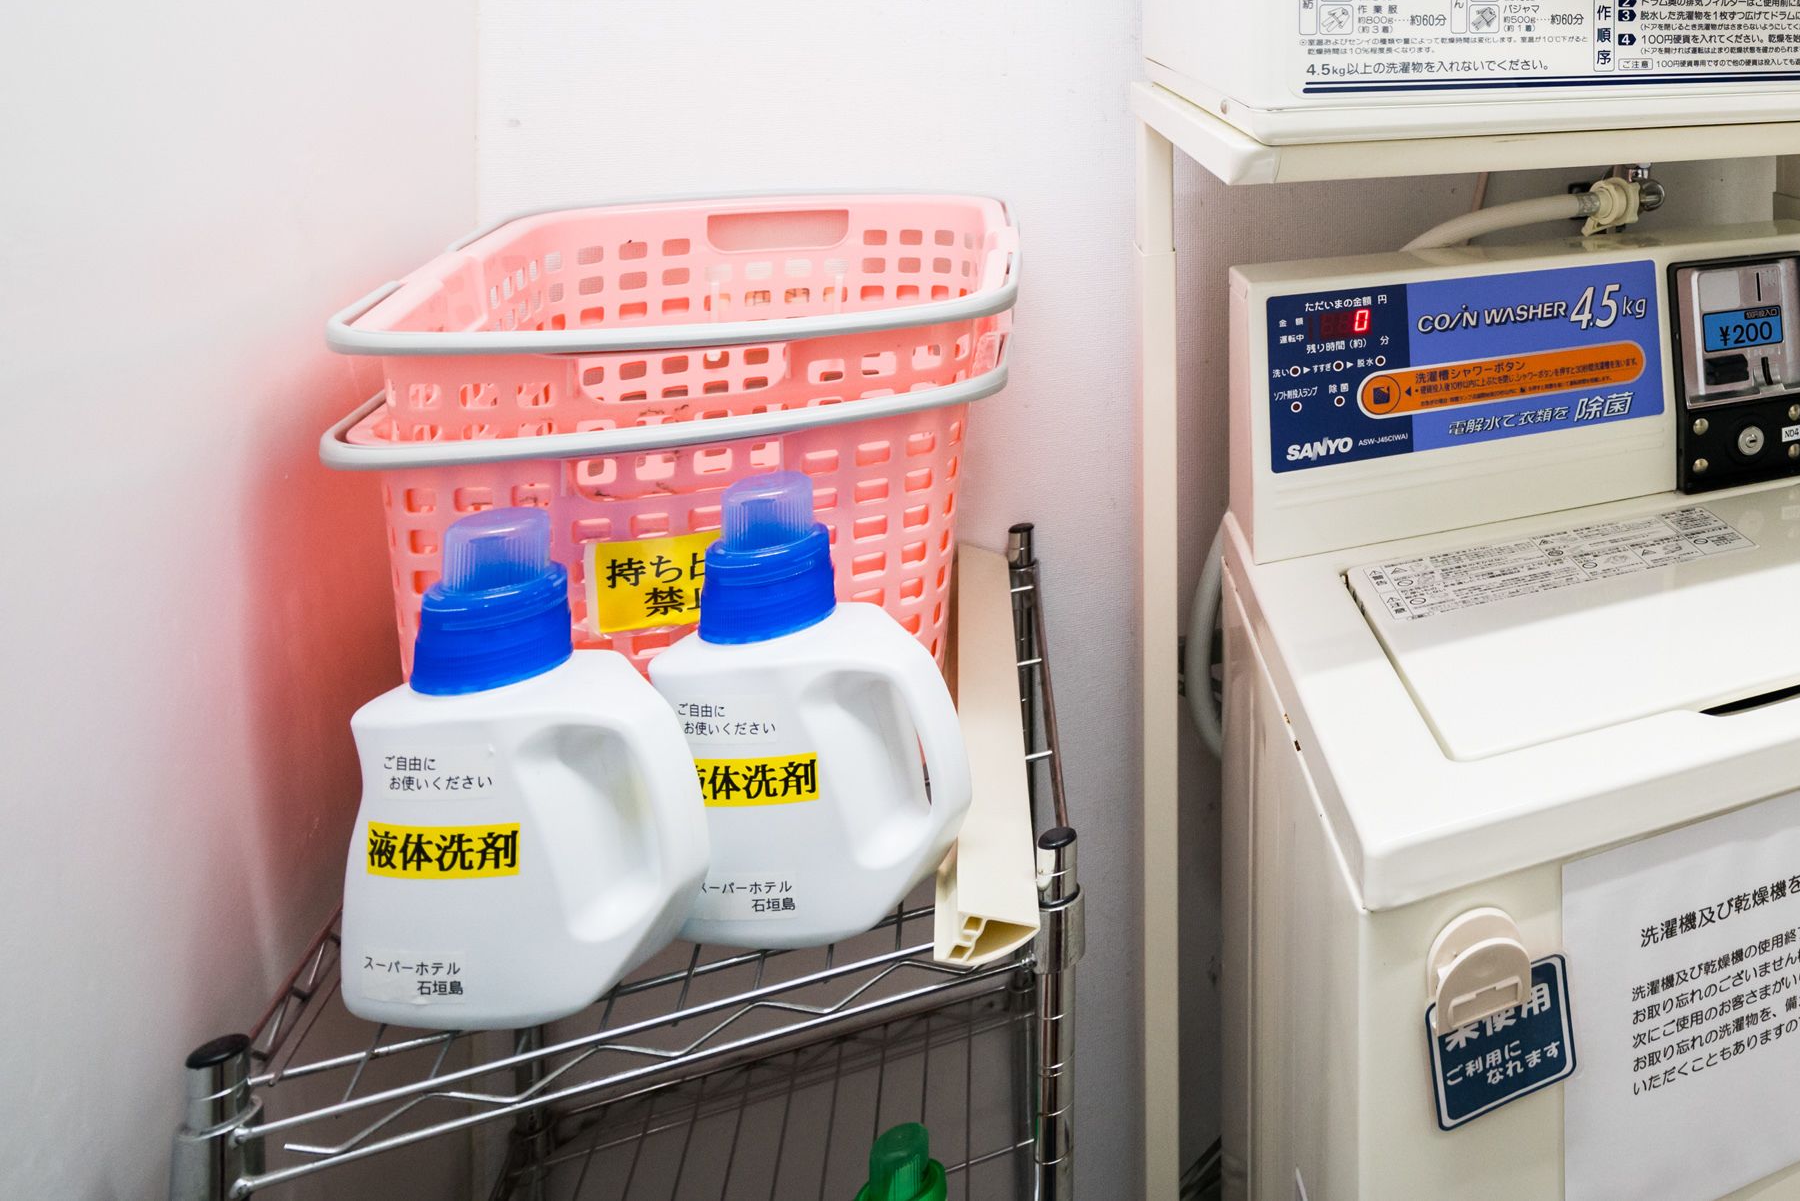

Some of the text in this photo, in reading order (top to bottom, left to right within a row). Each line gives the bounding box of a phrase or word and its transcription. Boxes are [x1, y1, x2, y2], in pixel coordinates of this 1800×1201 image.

[1503, 4, 1540, 14] パジャマ
[1410, 14, 1447, 27] 約60分
[1550, 13, 1584, 26] 約60分
[1306, 59, 1549, 77] 4.5kg以上の洗濯物を入れないでください。
[1622, 60, 1649, 69] ご注意
[1304, 294, 1388, 312] ただいまの金額 円
[1484, 301, 1568, 325] WASHER
[1570, 283, 1621, 330] 4.5
[1622, 295, 1647, 319] kg
[1354, 309, 1369, 332] 0
[1279, 334, 1305, 345] 運転中
[1719, 320, 1773, 347] ¥200
[1306, 335, 1390, 354] 残り時間(約) 分
[1272, 357, 1374, 379] 洗い すすぎ 脱水
[1415, 361, 1526, 385] 洗濯槽シャワーボタン
[1574, 390, 1634, 422] 除菌
[1286, 436, 1354, 463] SANYO
[678, 703, 726, 718] ご自由に
[684, 721, 776, 736] お使いください
[383, 755, 436, 773] ご自由に
[389, 773, 495, 792] お使いください
[368, 826, 520, 873] 液体洗剤
[751, 897, 796, 912] 石垣島
[363, 955, 462, 978] スーパーホテル
[416, 979, 464, 997] 石垣島
[1446, 1040, 1521, 1086] ご利用に
[1486, 1040, 1560, 1085] なれます
